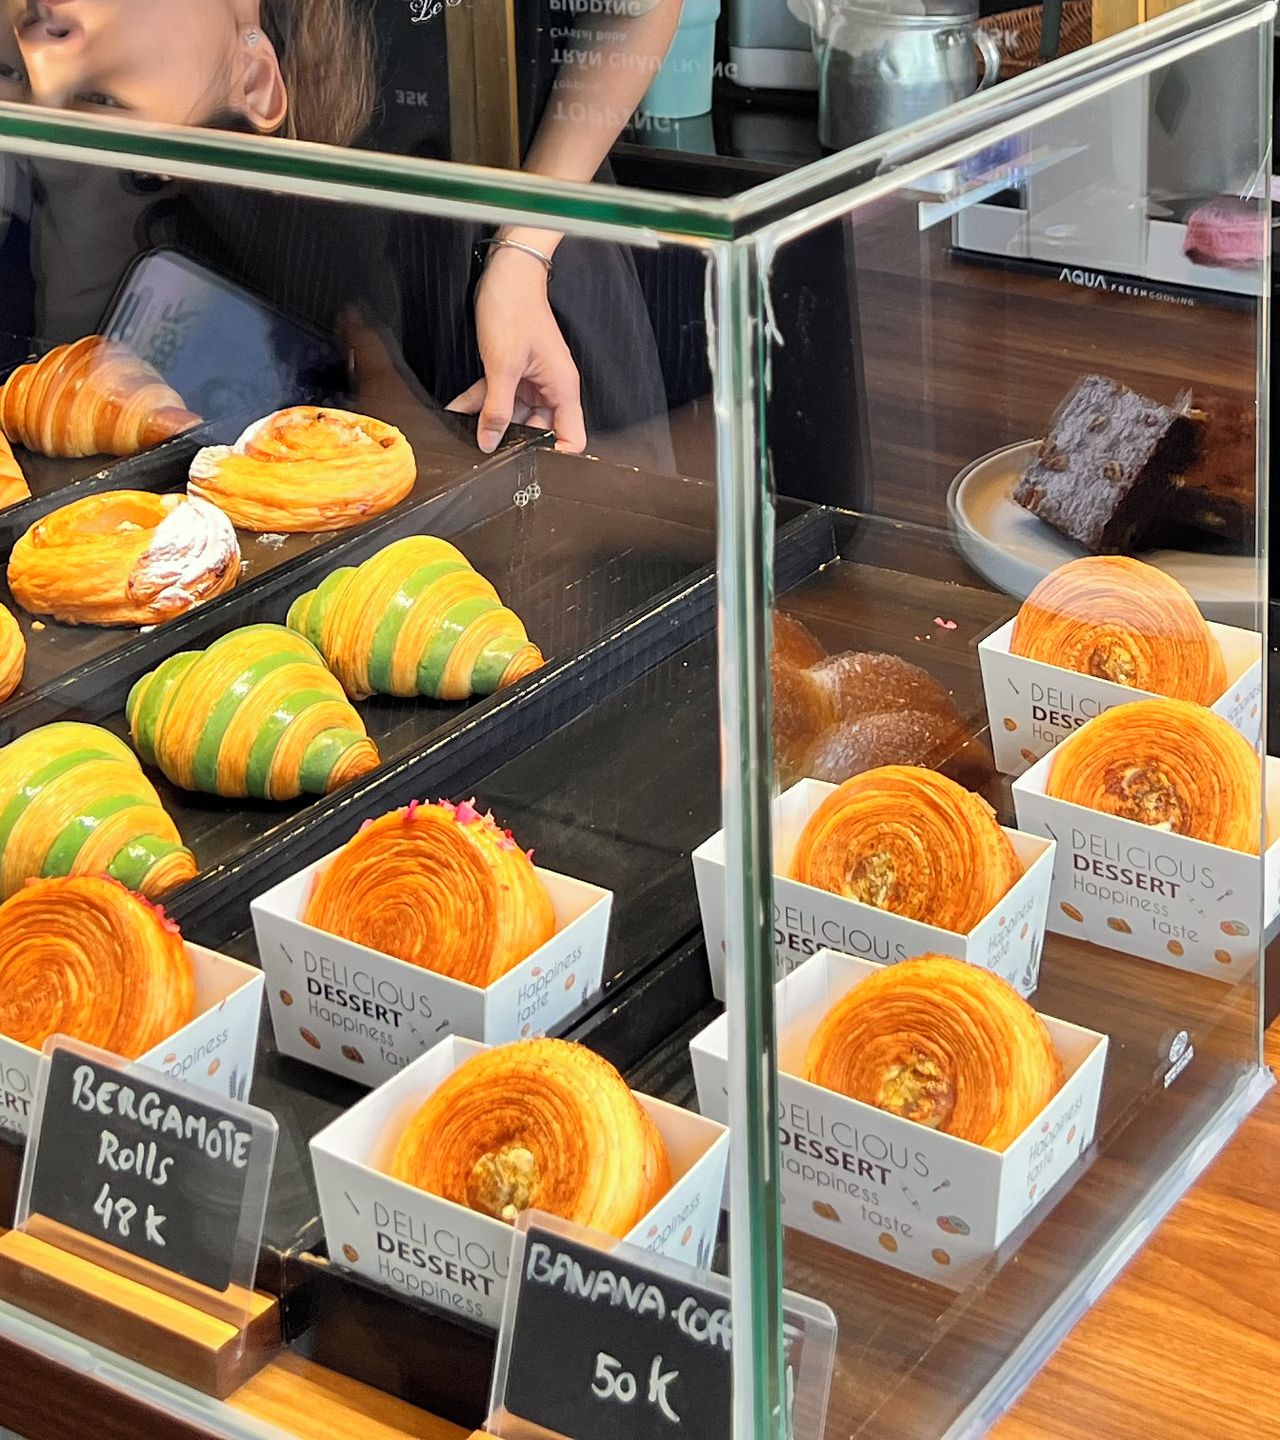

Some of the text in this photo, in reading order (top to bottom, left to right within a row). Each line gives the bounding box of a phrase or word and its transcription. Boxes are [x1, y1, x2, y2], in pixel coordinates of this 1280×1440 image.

[1058, 268, 1107, 290] AQUA
[1071, 828, 1215, 889] DELICIOUS
[1073, 853, 1181, 900] DESSERT
[1073, 873, 1168, 917] Happiness
[1153, 916, 1200, 943] taste
[72, 1065, 253, 1169] BERGAMOTE
[98, 1129, 174, 1186] Rolls
